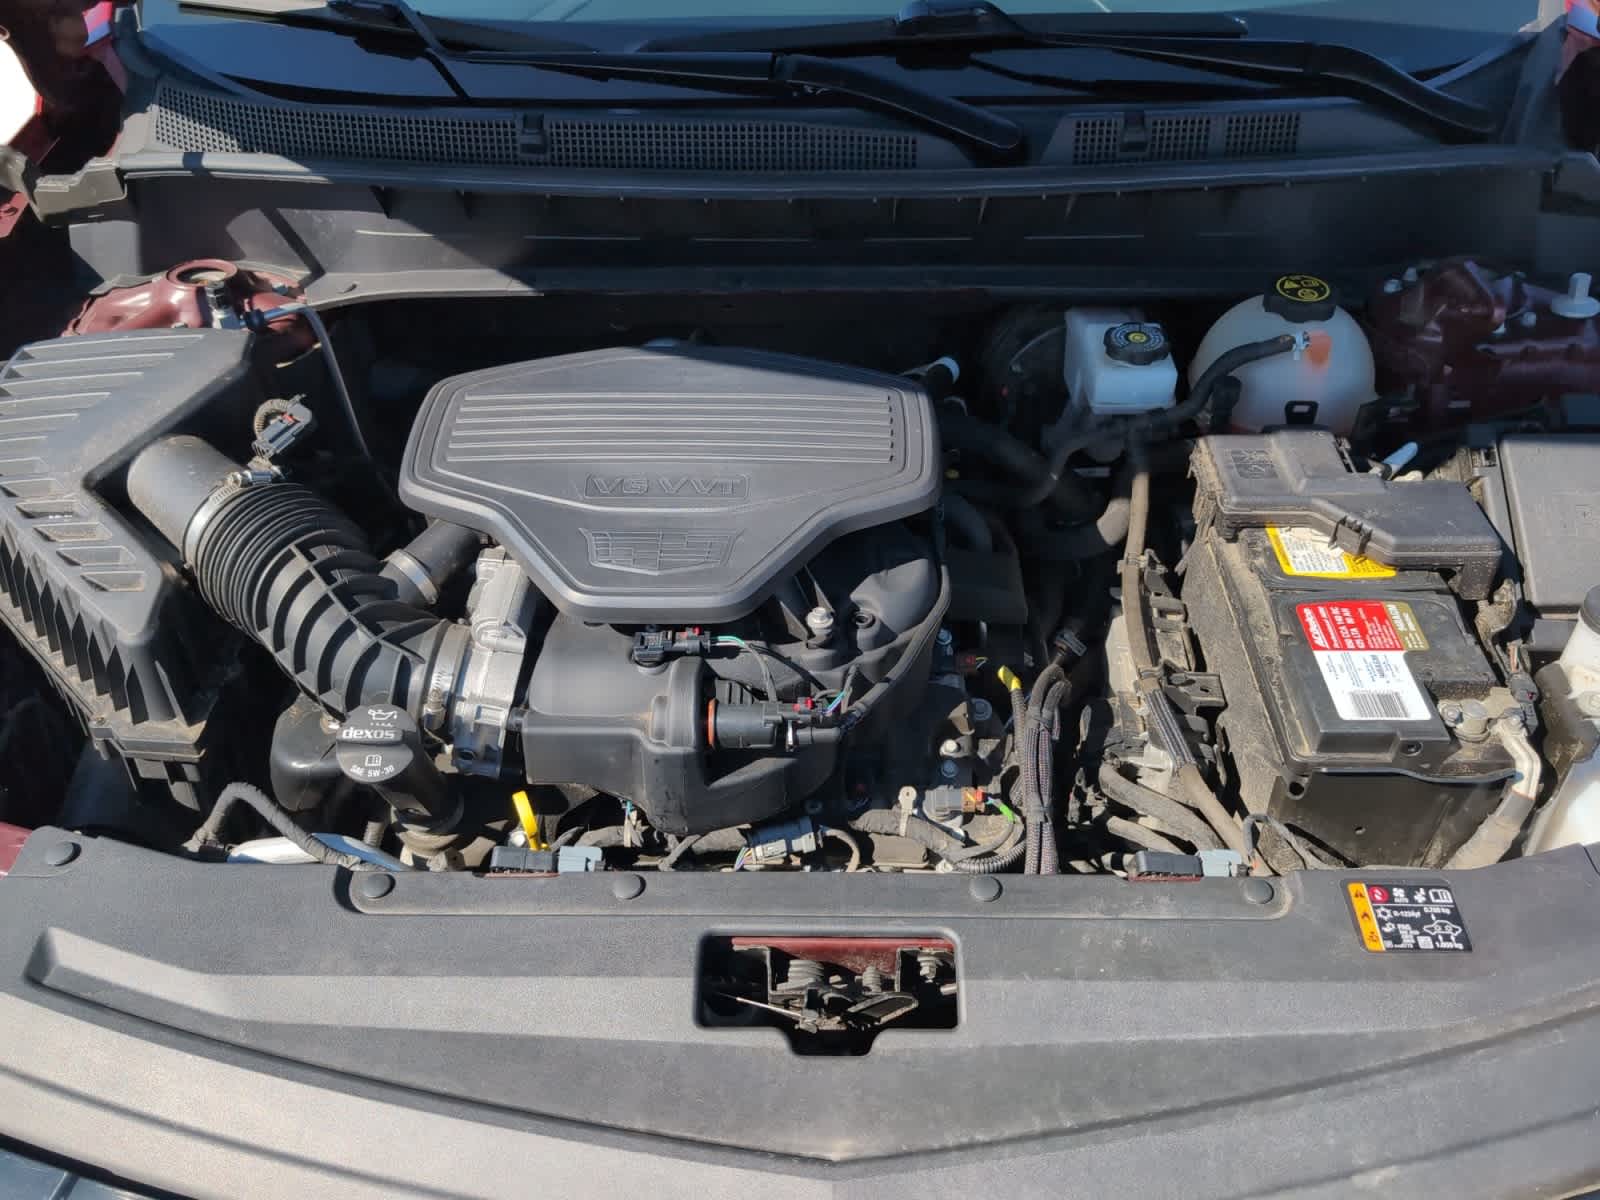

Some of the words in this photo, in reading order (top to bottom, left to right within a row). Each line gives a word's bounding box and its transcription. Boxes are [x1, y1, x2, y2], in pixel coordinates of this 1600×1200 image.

[657, 477, 741, 495] VVT
[1303, 607, 1327, 647] ACDelco
[1338, 625, 1351, 638] CCA
[342, 727, 396, 739] dexos
